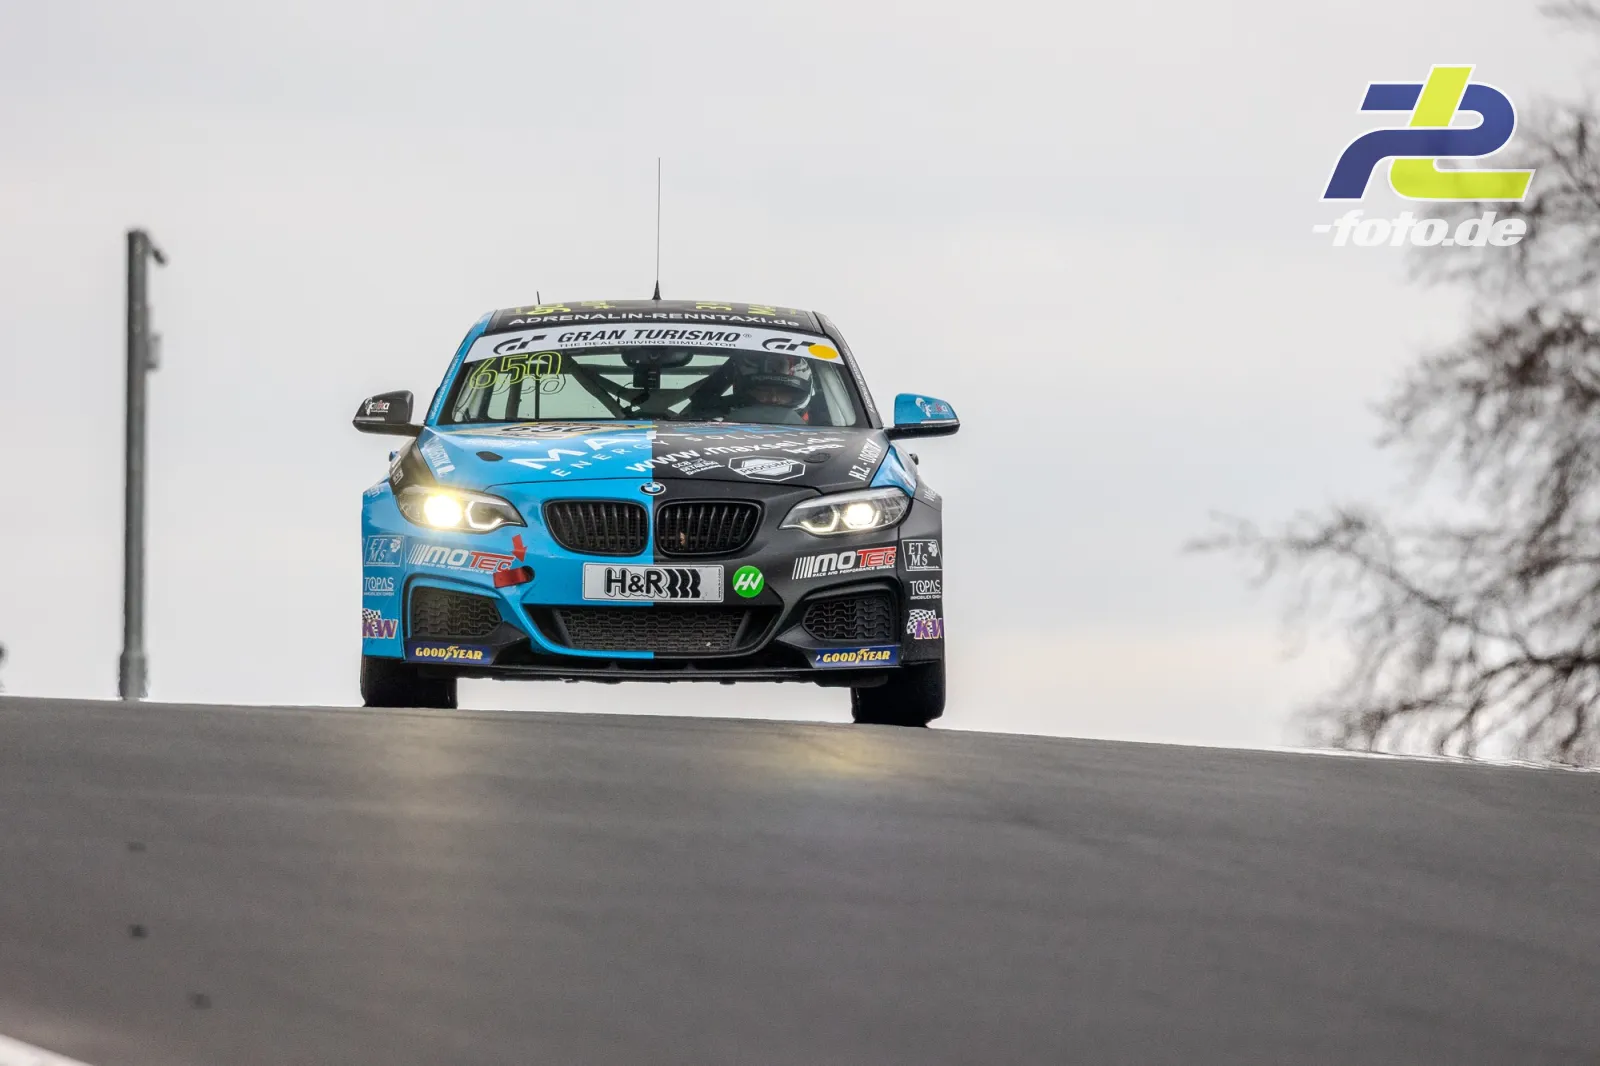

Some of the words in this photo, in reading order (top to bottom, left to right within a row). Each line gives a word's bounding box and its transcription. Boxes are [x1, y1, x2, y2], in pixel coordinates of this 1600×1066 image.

[509, 312, 800, 327] ADRENALIN-RENNTAXI.de
[557, 329, 627, 344] GRAN
[669, 340, 736, 348] SIMULATOR
[469, 351, 562, 389] 650
[364, 577, 395, 592] TOPAS
[604, 566, 668, 598] H&R
[909, 580, 942, 595] TOPAS
[362, 618, 399, 640] KW
[415, 645, 483, 661] GOODYEAR
[822, 648, 891, 664] GOODYEAR
